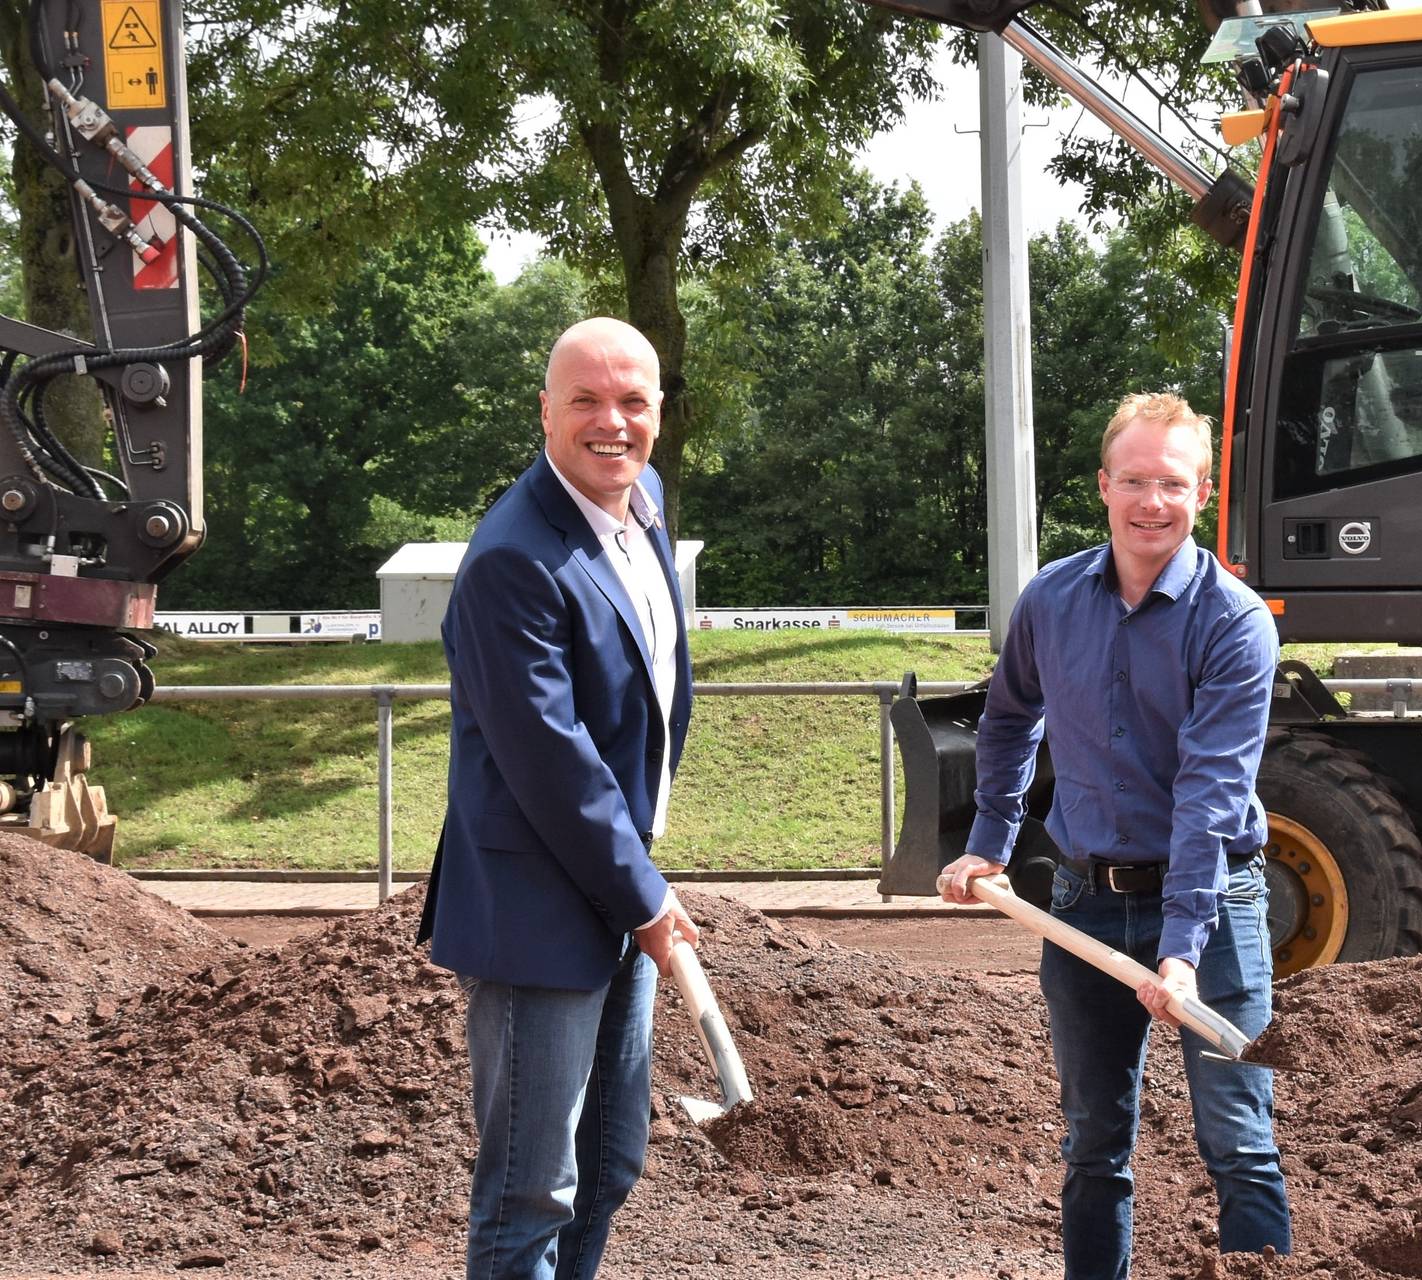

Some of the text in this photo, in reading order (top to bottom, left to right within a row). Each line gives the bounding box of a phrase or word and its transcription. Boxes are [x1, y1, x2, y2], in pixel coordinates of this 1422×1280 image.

[733, 617, 821, 630] Sparkasse
[853, 613, 931, 622] SCHUMACHER
[187, 622, 240, 634] ALLOY
